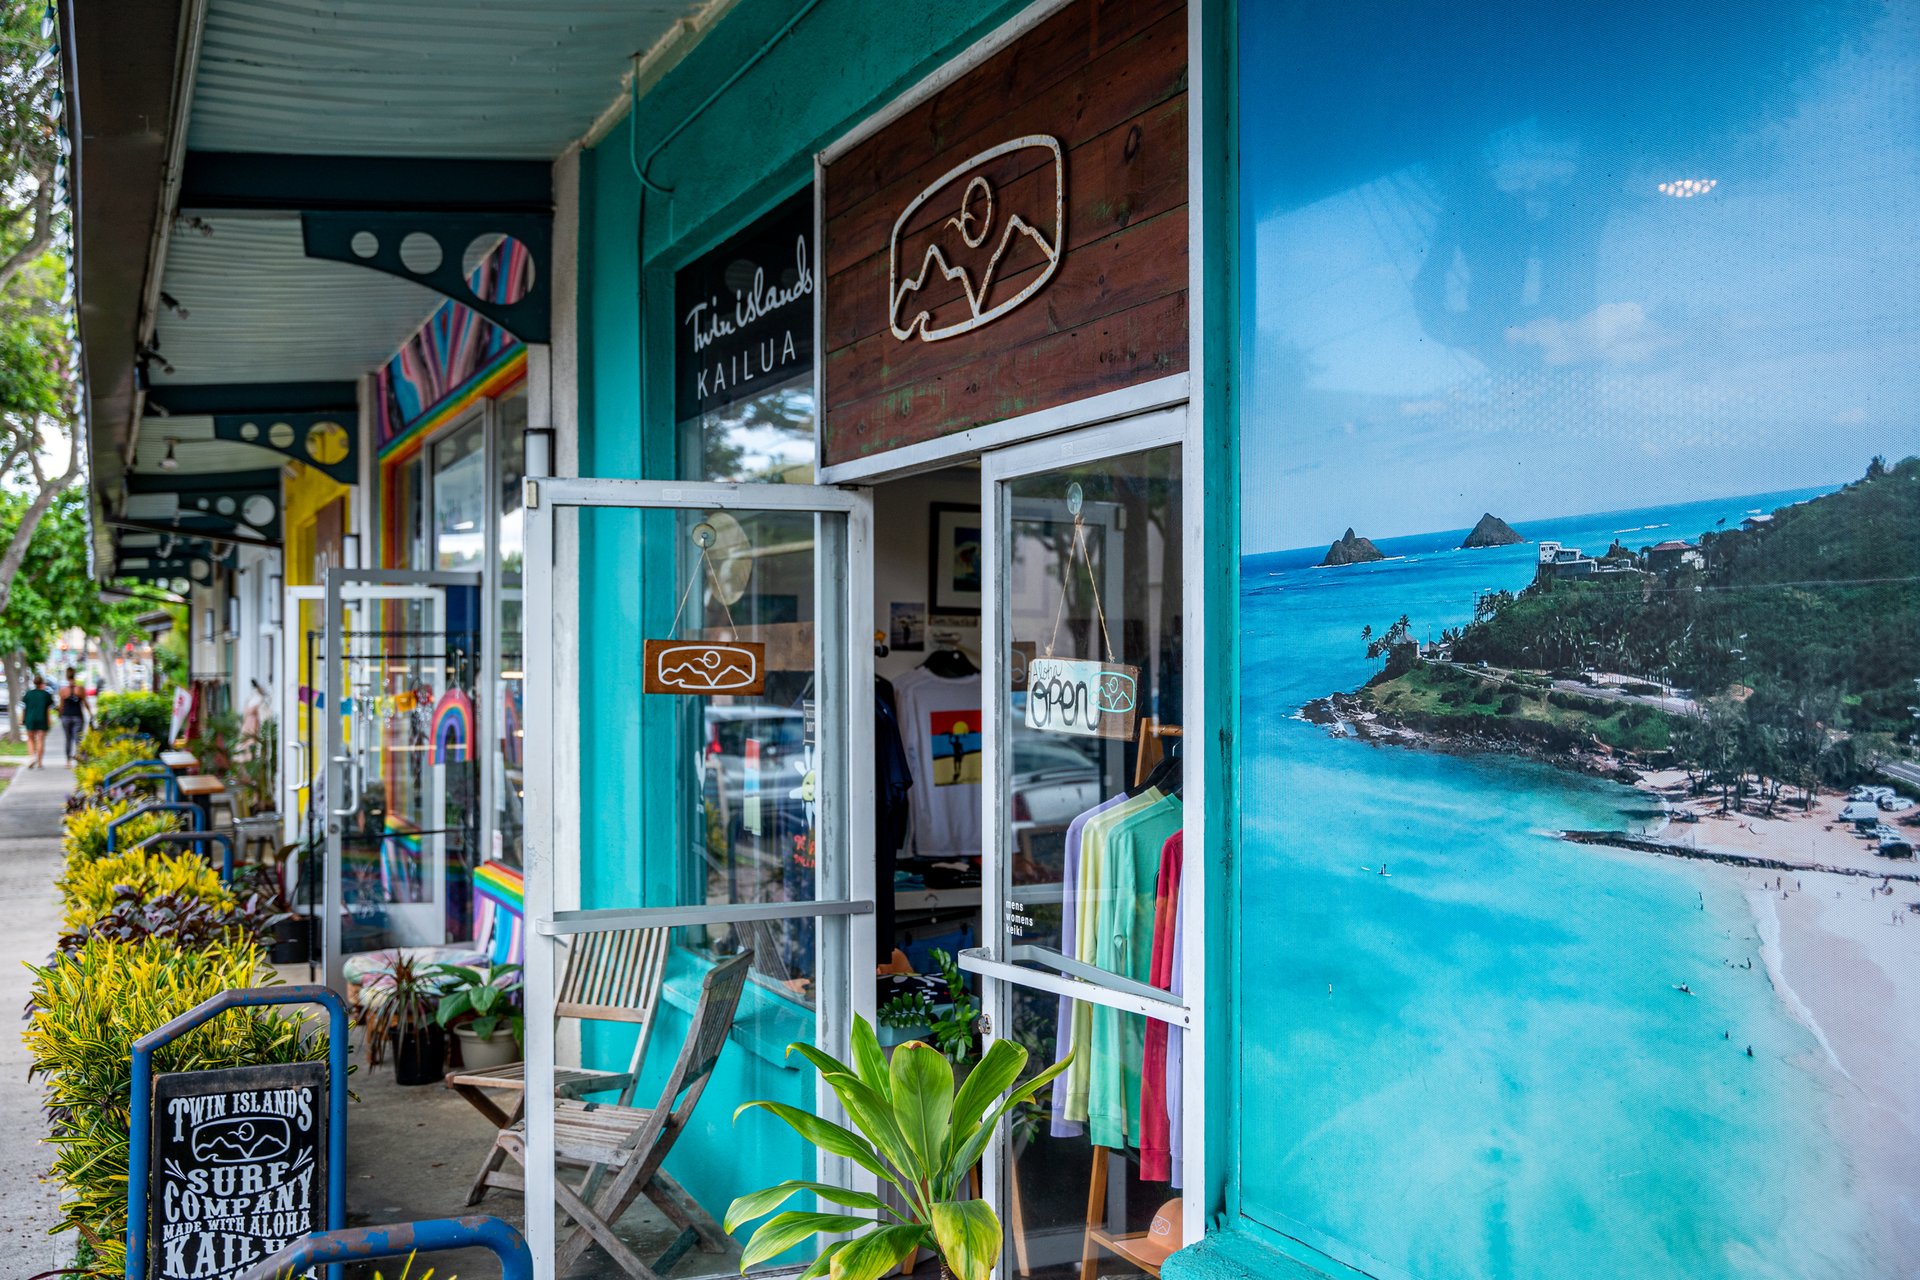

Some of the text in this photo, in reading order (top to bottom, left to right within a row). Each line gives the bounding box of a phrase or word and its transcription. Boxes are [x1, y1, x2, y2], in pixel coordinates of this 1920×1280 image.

[685, 234, 813, 353] Twin islands
[698, 330, 796, 400] KAILUA
[1005, 900, 1024, 911] mens
[1005, 913, 1034, 927] womens
[1005, 923, 1023, 937] keiki
[168, 1088, 313, 1142] TWIN ISLANDS
[164, 1161, 315, 1223] COMPANY
[187, 1162, 290, 1196] SURF
[163, 1210, 312, 1242] MADE WITH ALOHA
